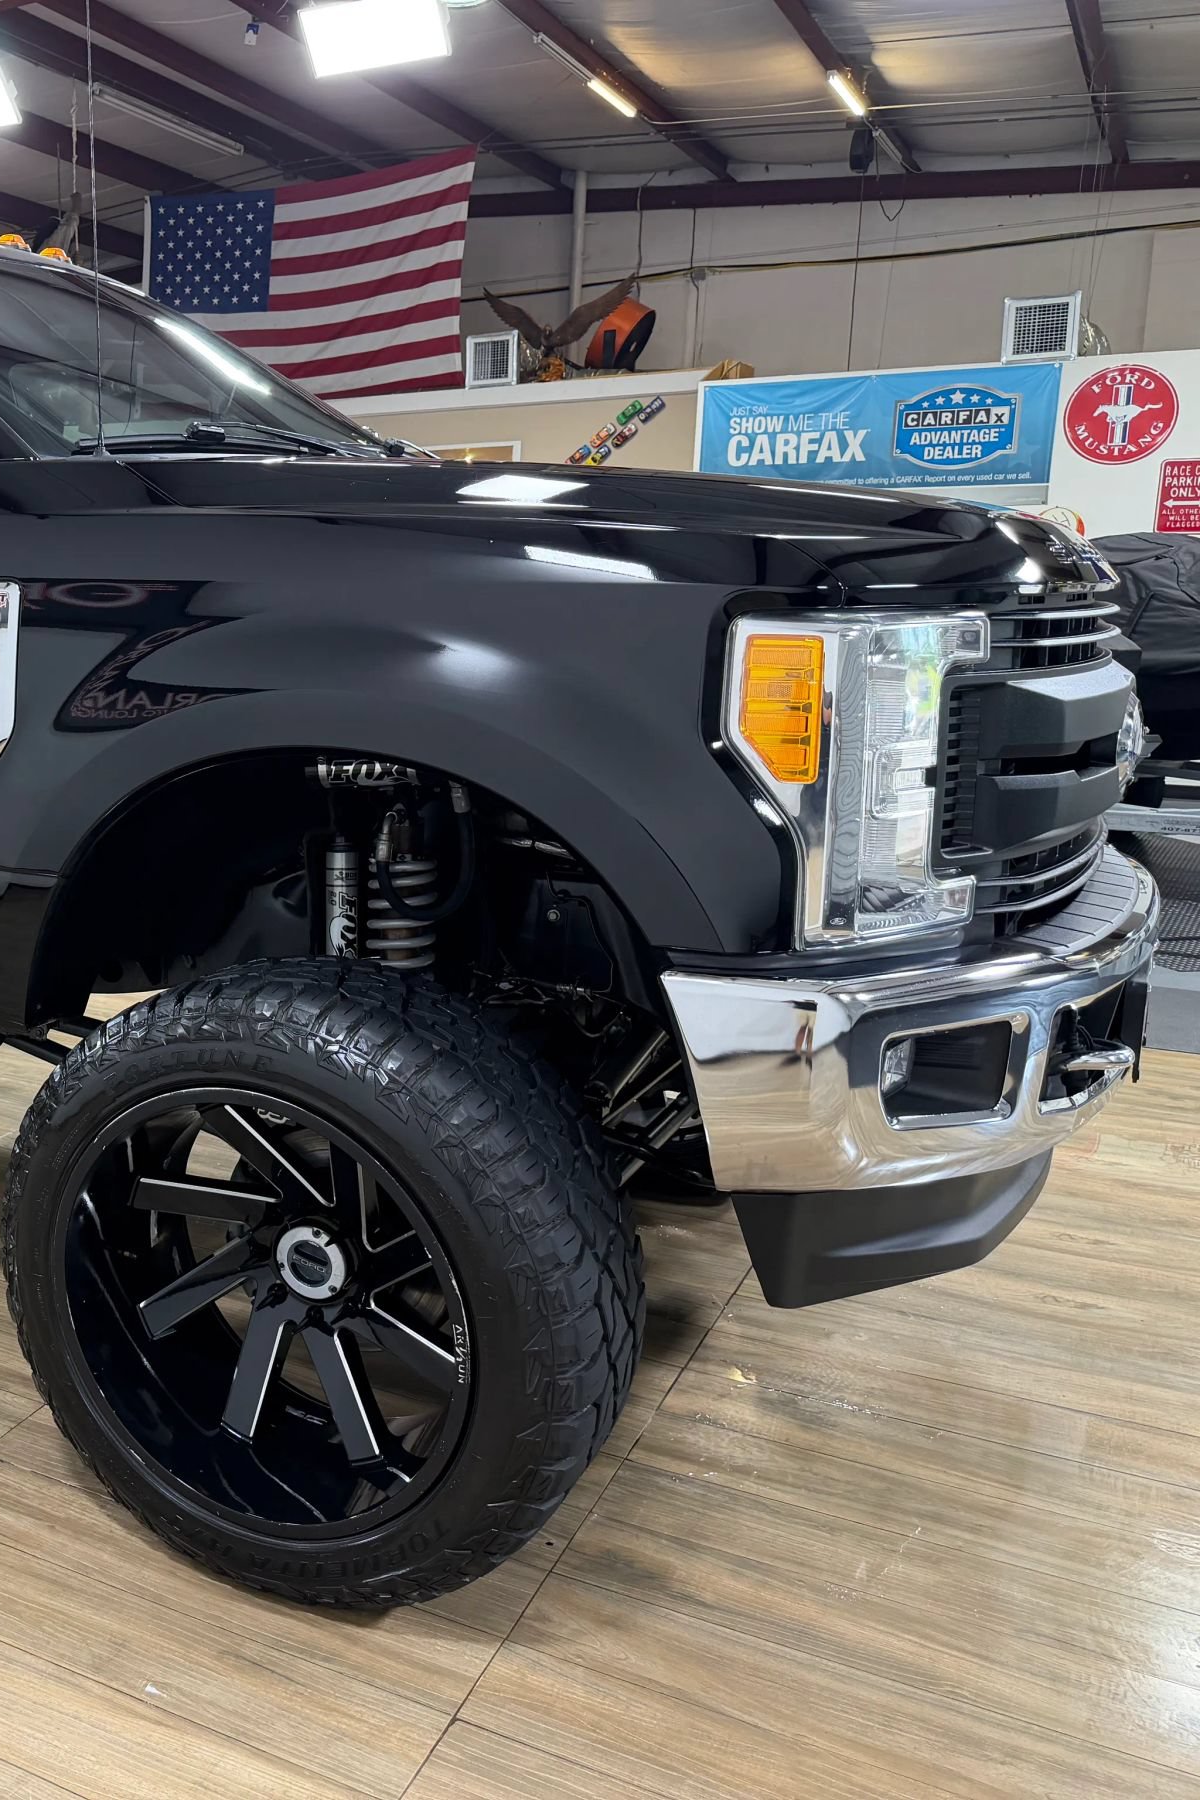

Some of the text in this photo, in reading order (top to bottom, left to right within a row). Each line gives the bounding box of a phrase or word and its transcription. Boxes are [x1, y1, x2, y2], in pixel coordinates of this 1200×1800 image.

[1091, 368, 1155, 394] FORD
[729, 405, 769, 416] JUST SAY
[905, 409, 1006, 427] CARFAX
[729, 411, 850, 434] SHOW ME THE
[909, 428, 1000, 446] ADVANTAGE
[1075, 421, 1164, 456] MUSTANG
[727, 429, 867, 467] CARFAX
[923, 445, 982, 460] DEALER
[924, 474, 946, 483] Report
[957, 475, 975, 483] every
[976, 473, 993, 481] used
[1018, 472, 1032, 480] sell.
[1165, 465, 1192, 476] RACE
[329, 759, 408, 785] FOX
[338, 891, 358, 960] FOX
